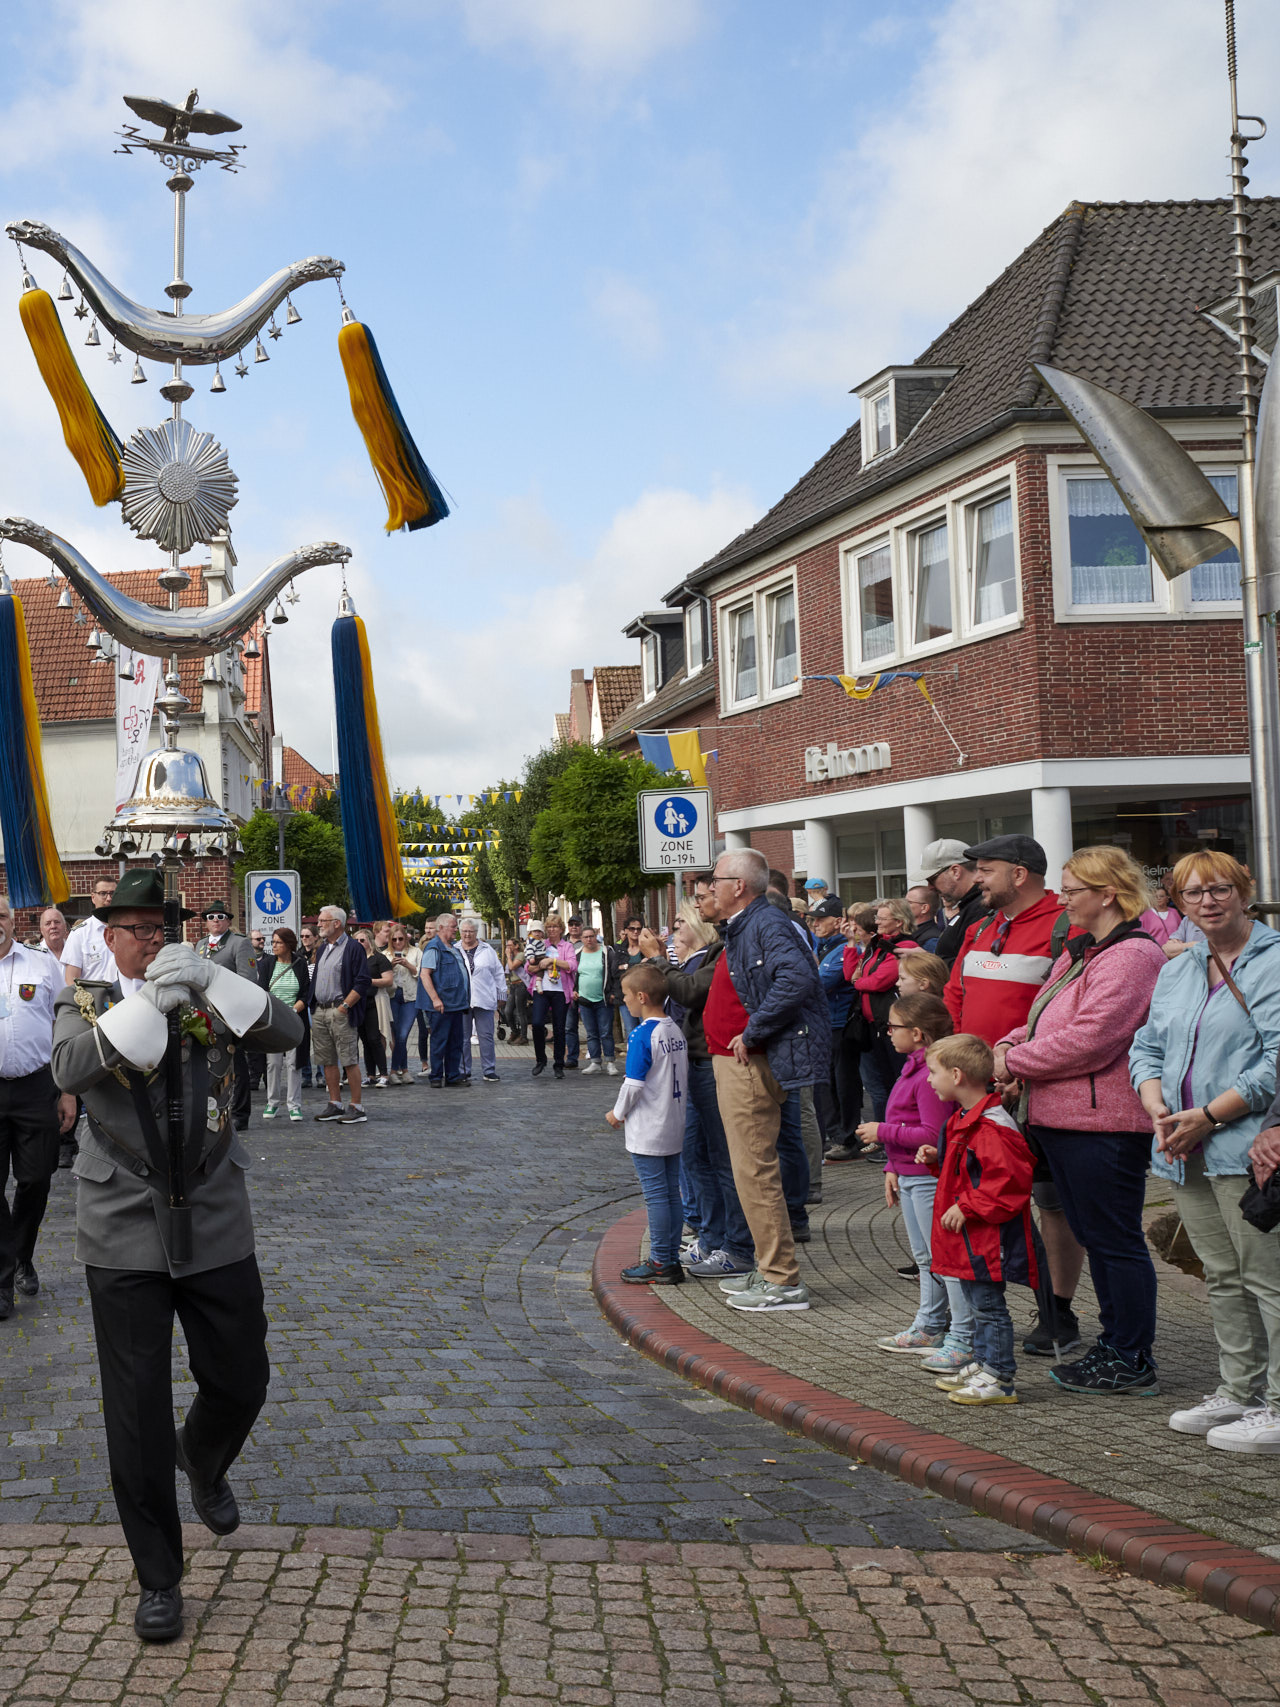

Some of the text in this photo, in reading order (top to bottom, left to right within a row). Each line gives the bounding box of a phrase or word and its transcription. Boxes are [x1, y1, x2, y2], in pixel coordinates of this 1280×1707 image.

[660, 840, 694, 852] ZONE
[660, 853, 696, 865] 10-19 h
[262, 916, 286, 924] ZONE
